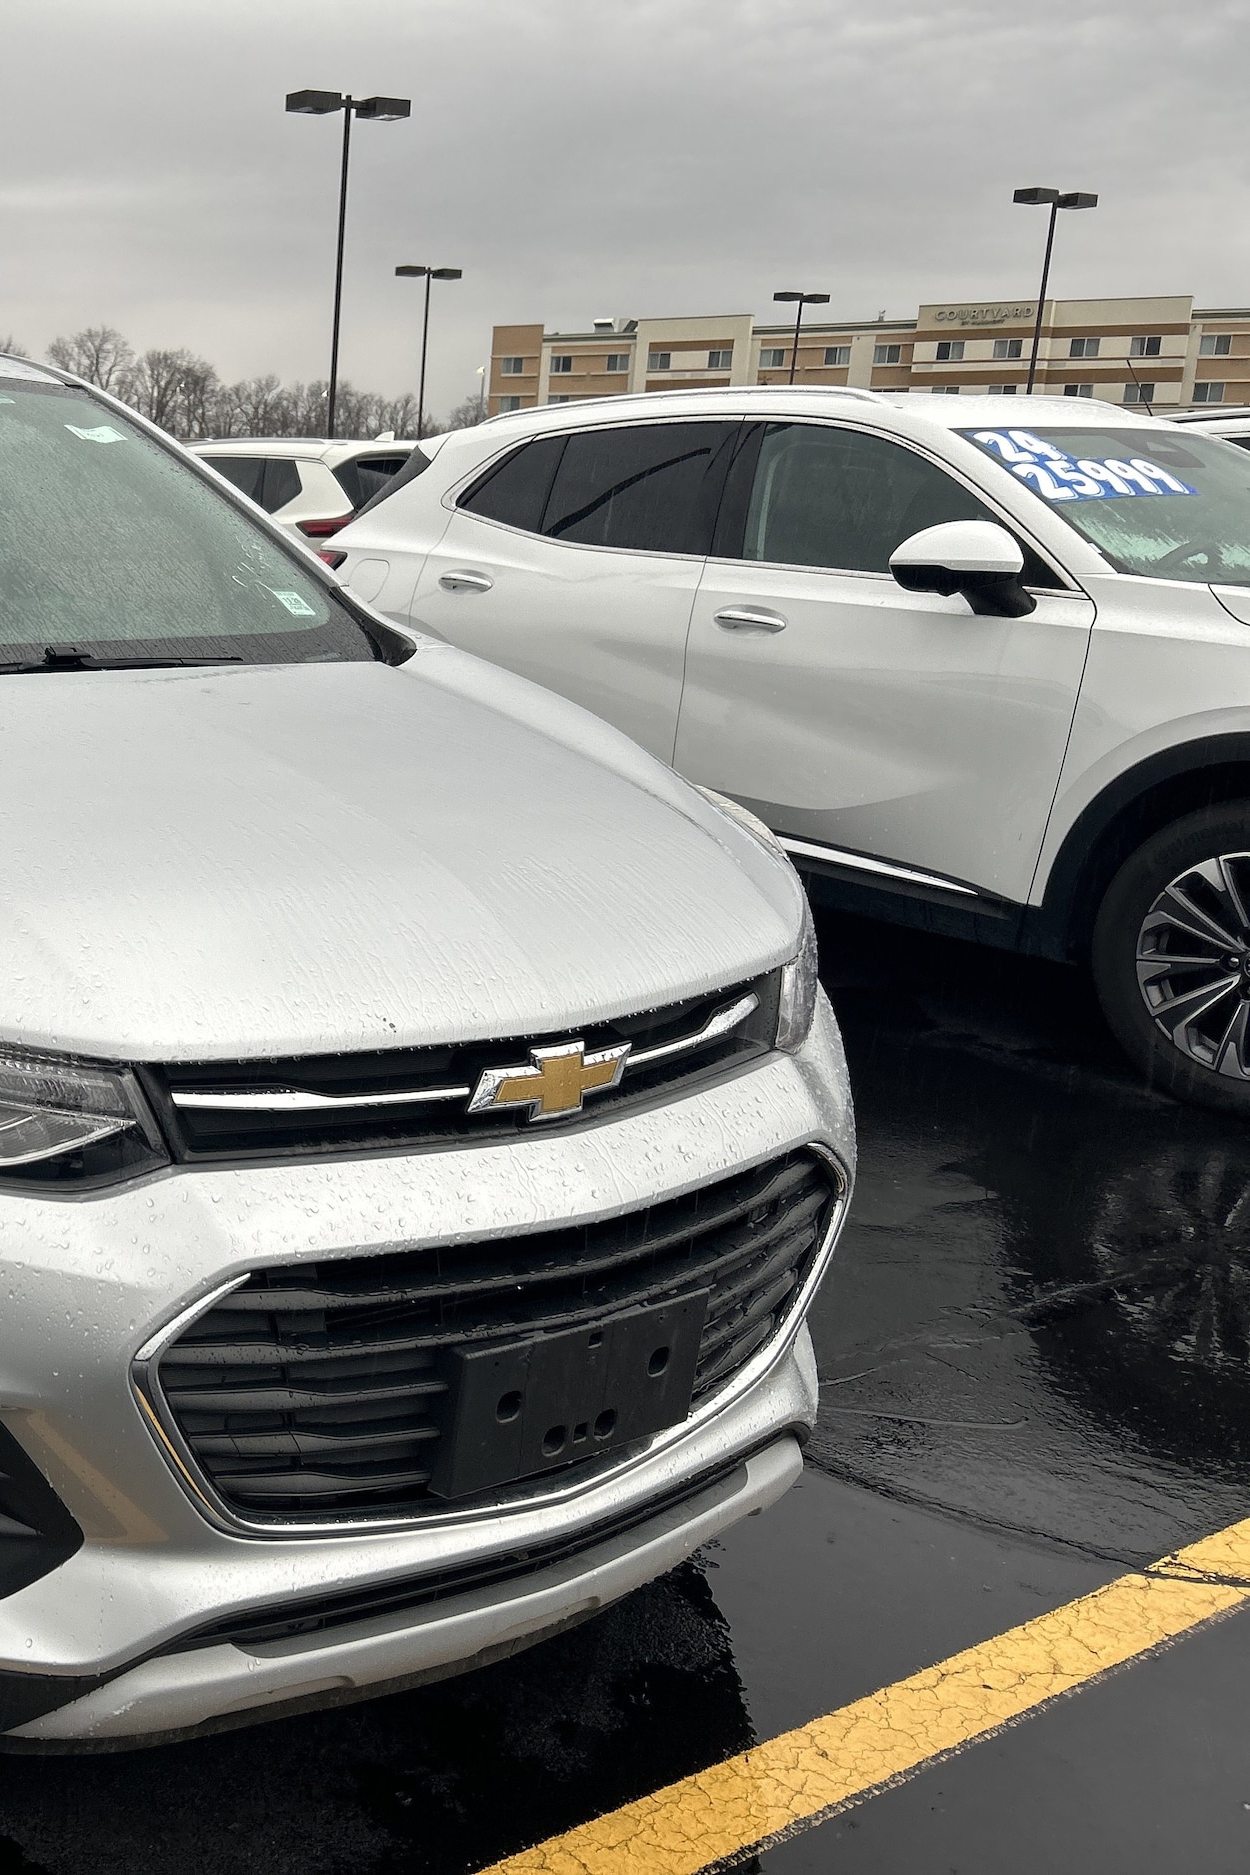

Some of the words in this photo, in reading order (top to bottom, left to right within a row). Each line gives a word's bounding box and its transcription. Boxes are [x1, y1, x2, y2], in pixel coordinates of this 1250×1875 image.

[935, 306, 1034, 321] COURTYARD
[973, 430, 1068, 463] 24
[1011, 458, 1190, 500] 25999
